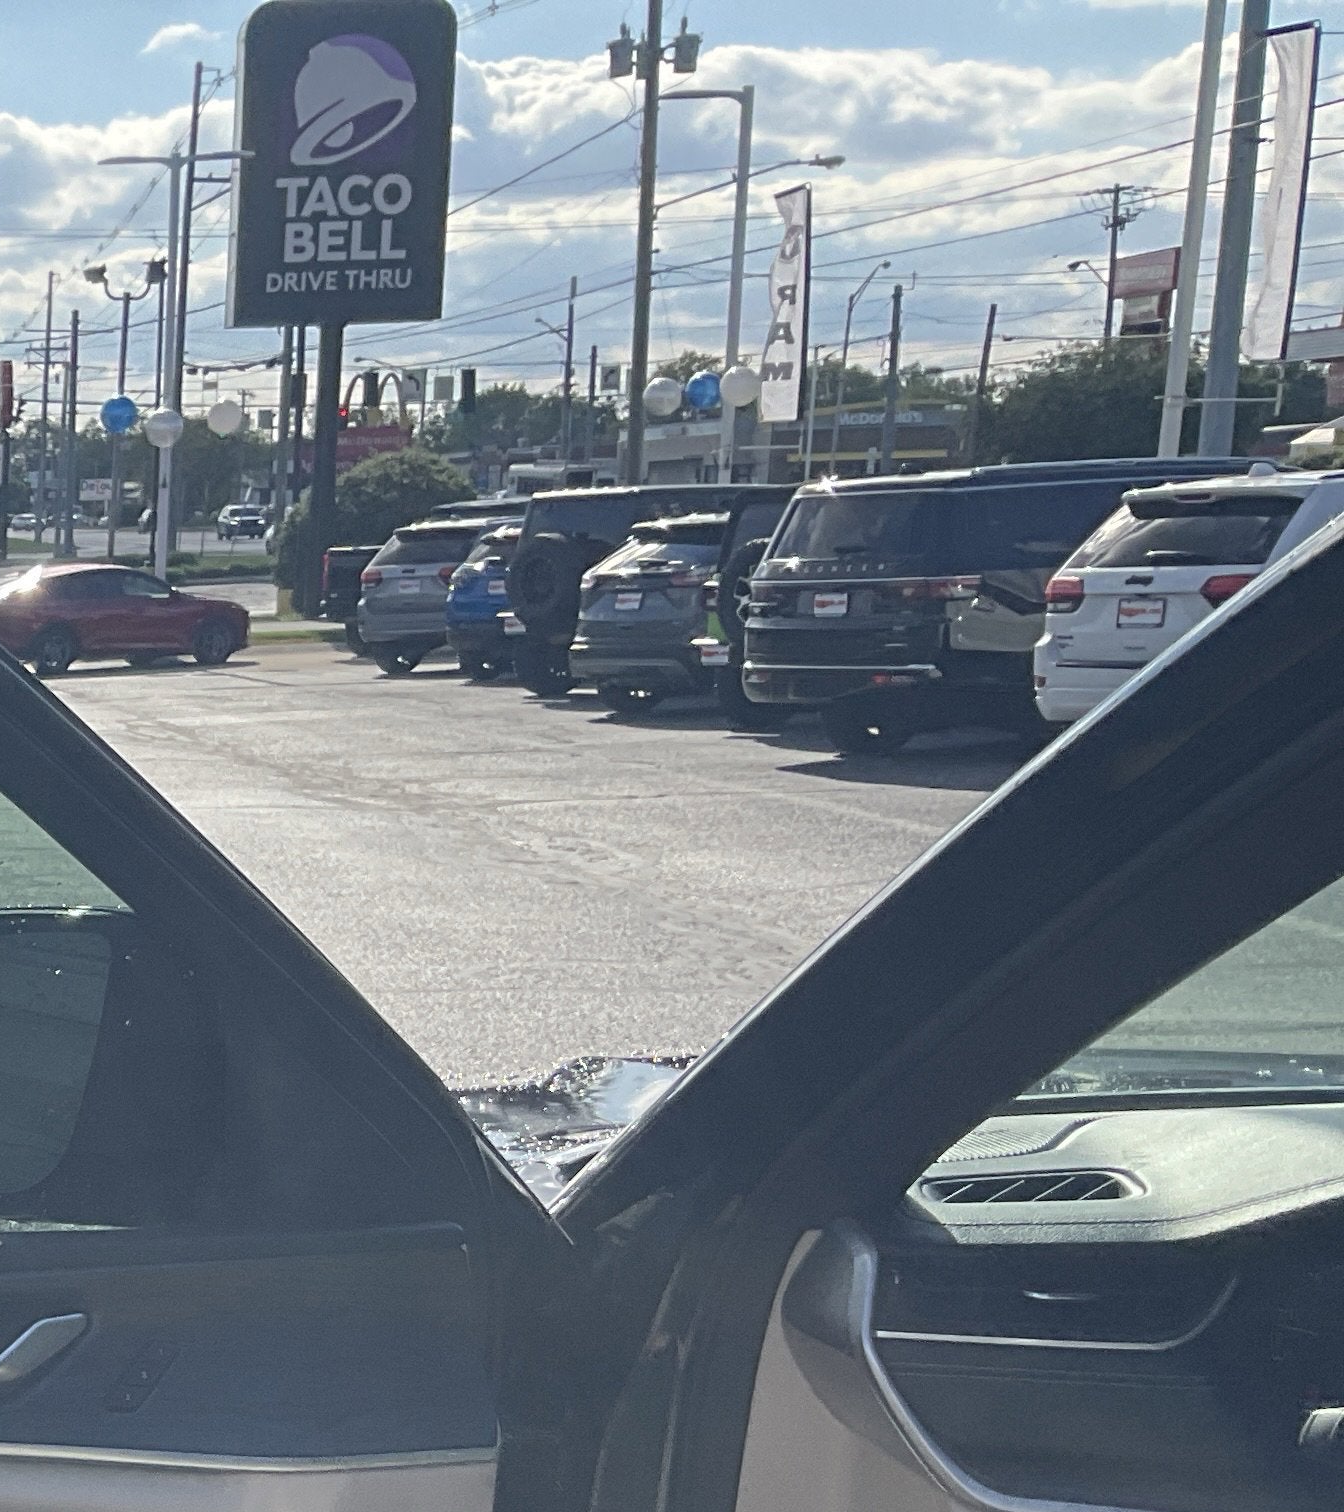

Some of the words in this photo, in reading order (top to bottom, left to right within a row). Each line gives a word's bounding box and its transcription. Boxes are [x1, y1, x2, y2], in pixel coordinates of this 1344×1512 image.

[275, 173, 412, 218] TACO
[283, 219, 406, 263] BELL
[265, 270, 338, 293] DRIVE
[345, 268, 411, 290] THRU
